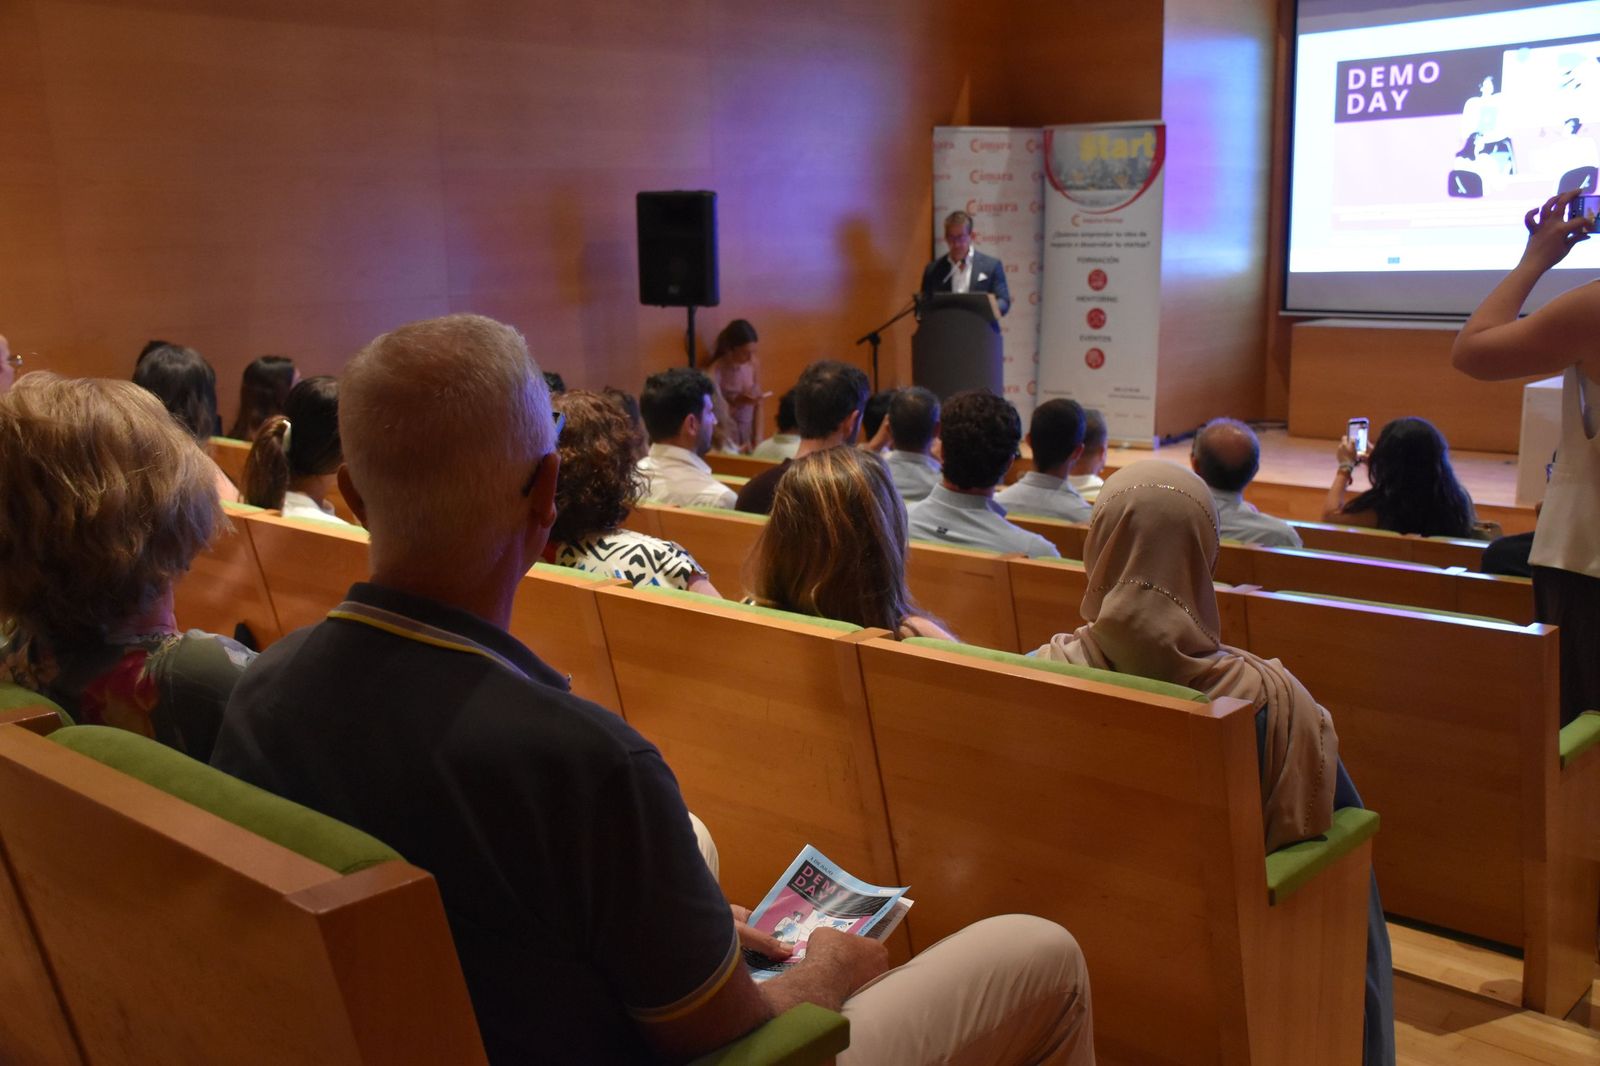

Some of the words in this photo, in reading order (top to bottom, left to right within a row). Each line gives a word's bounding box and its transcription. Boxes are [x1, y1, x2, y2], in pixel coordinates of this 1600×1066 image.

[1347, 61, 1440, 90] DEMO
[1346, 89, 1409, 115] DAY
[794, 875, 827, 900] DAY
[802, 865, 849, 900] DEMO
